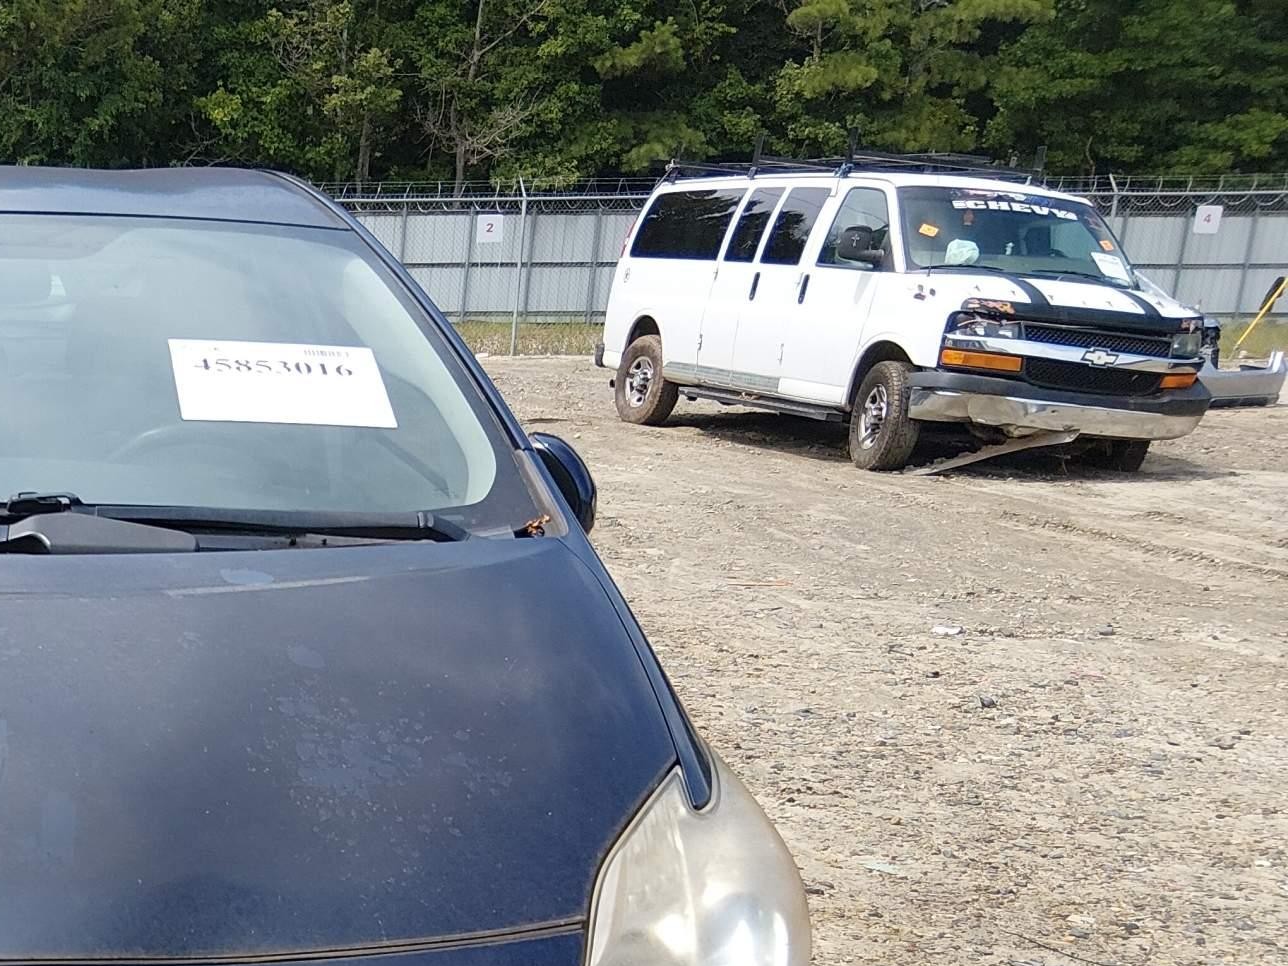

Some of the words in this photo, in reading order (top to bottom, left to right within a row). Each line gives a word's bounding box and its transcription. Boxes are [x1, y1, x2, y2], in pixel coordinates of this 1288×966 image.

[964, 199, 1069, 219] CHEVY
[1202, 213, 1212, 223] 4
[485, 222, 494, 233] 2
[194, 358, 353, 377] 45853016
